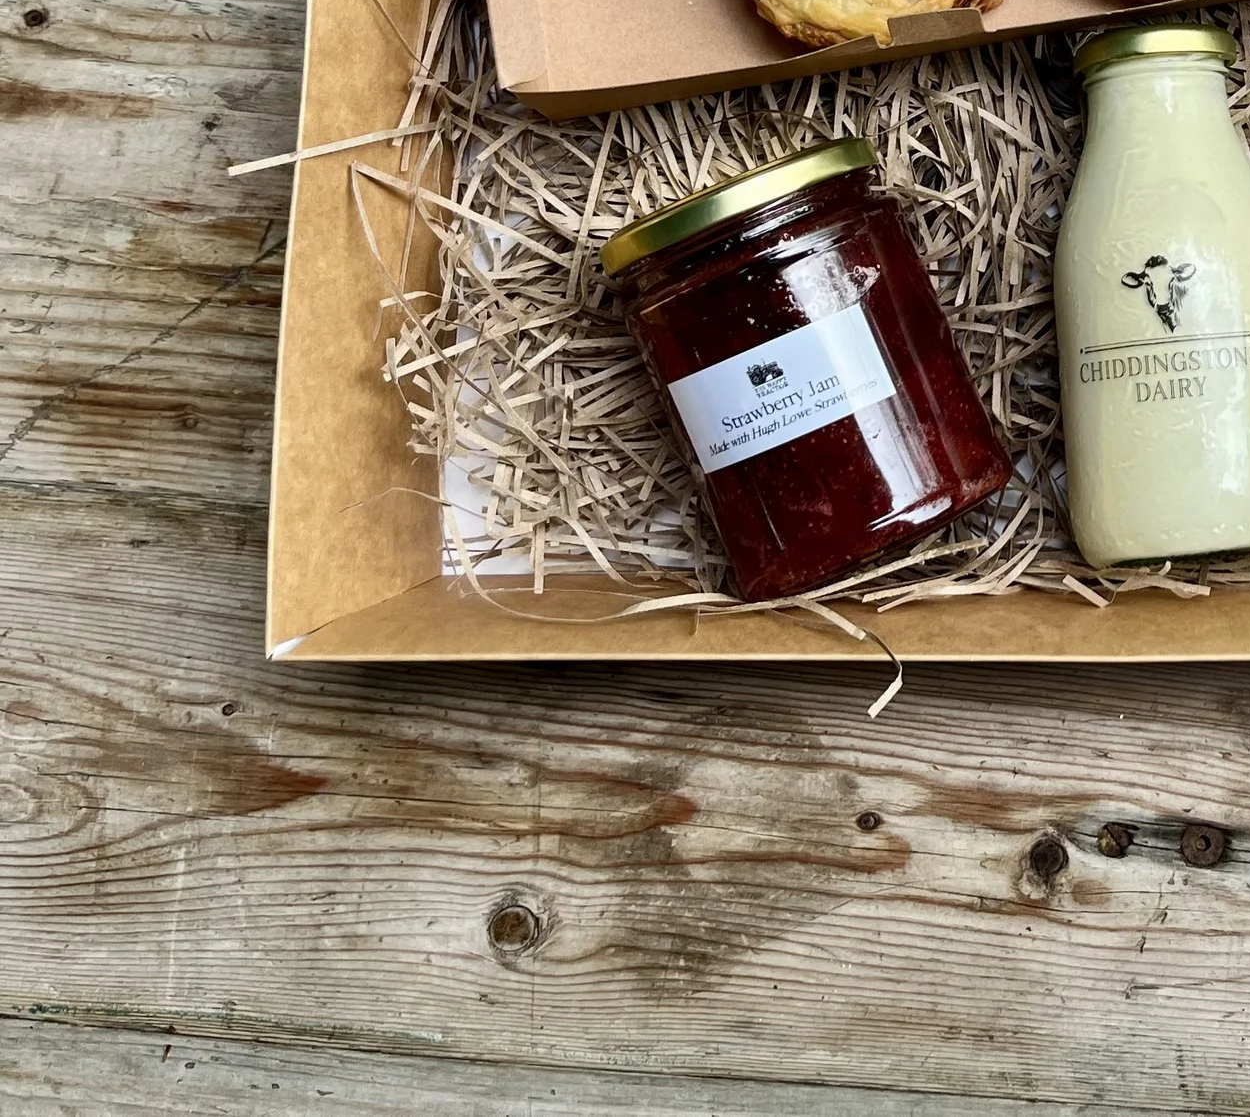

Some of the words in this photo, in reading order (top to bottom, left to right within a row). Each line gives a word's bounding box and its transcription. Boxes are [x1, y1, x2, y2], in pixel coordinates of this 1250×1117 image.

[721, 389, 804, 432] Strawberry
[808, 375, 841, 397] Jam
[1136, 376, 1208, 402] DAIRY
[709, 441, 730, 457] Made
[730, 433, 750, 446] with
[752, 418, 781, 439] Hugh
[783, 407, 812, 426] Lowe
